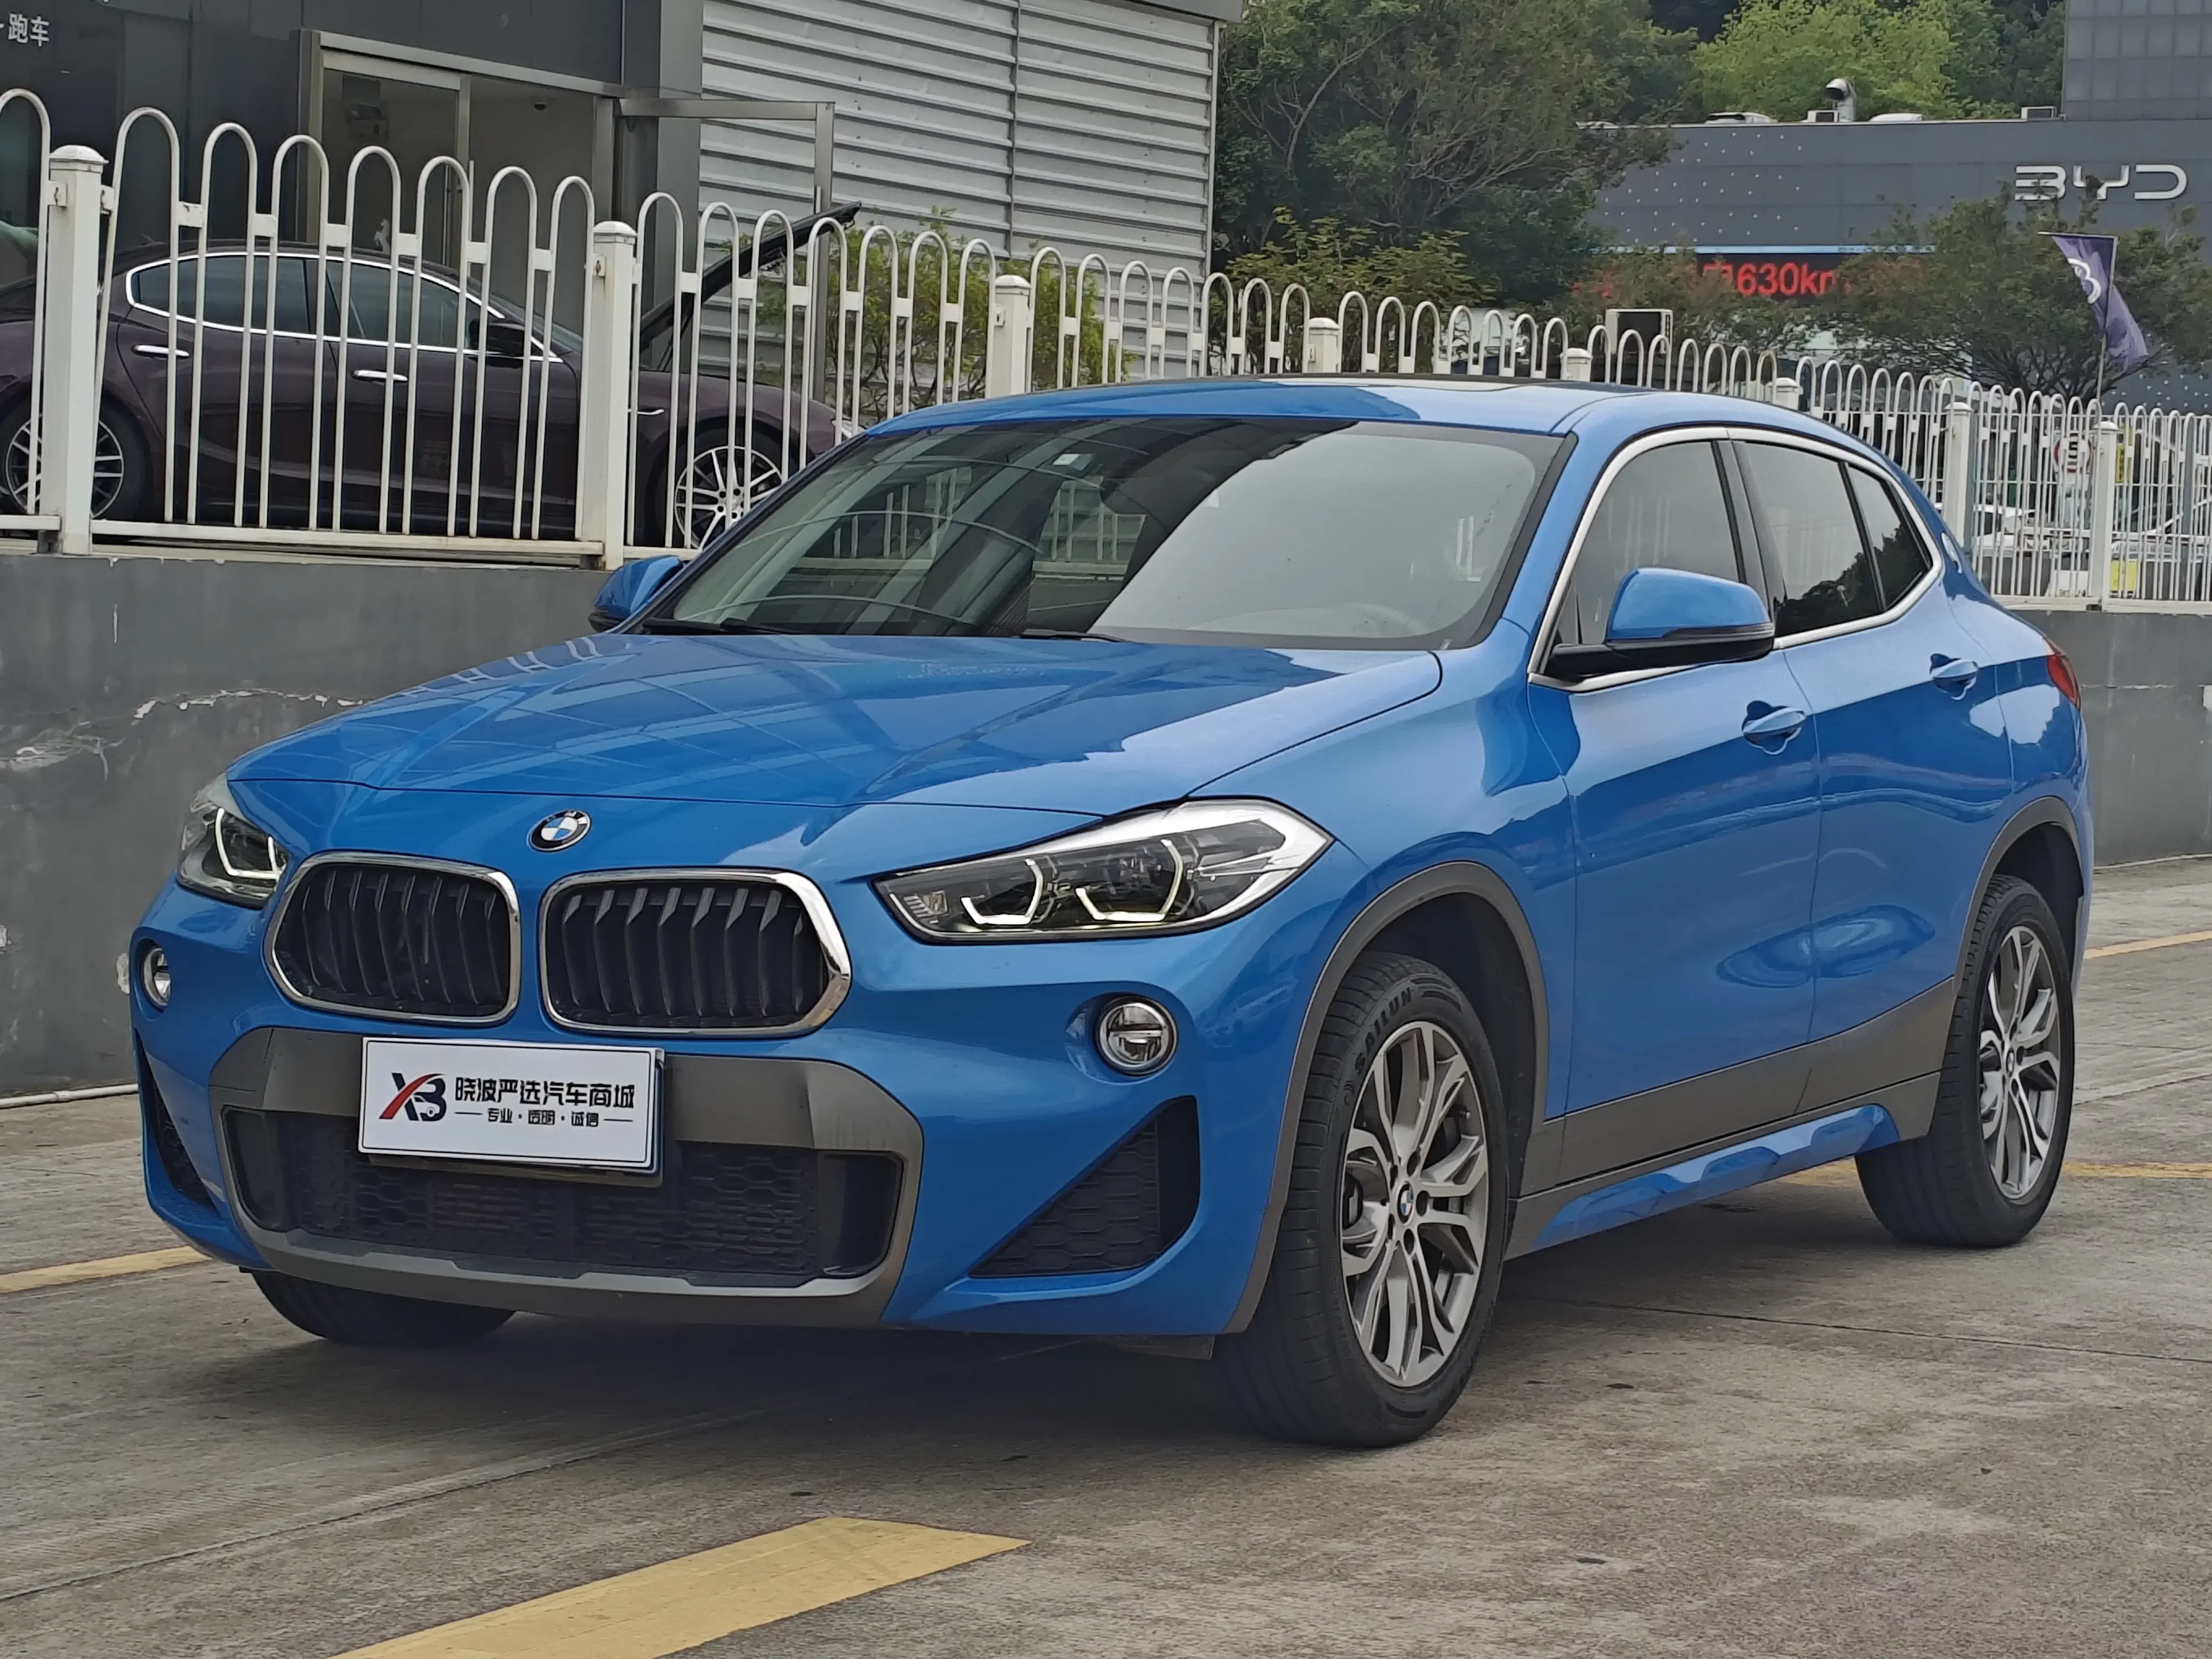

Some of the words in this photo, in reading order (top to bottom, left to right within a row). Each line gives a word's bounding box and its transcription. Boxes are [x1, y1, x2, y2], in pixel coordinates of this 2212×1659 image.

[0, 13, 50, 48] 跑车
[2014, 164, 2188, 200] BYD
[455, 1077, 635, 1109] 晓波严选汽车商城
